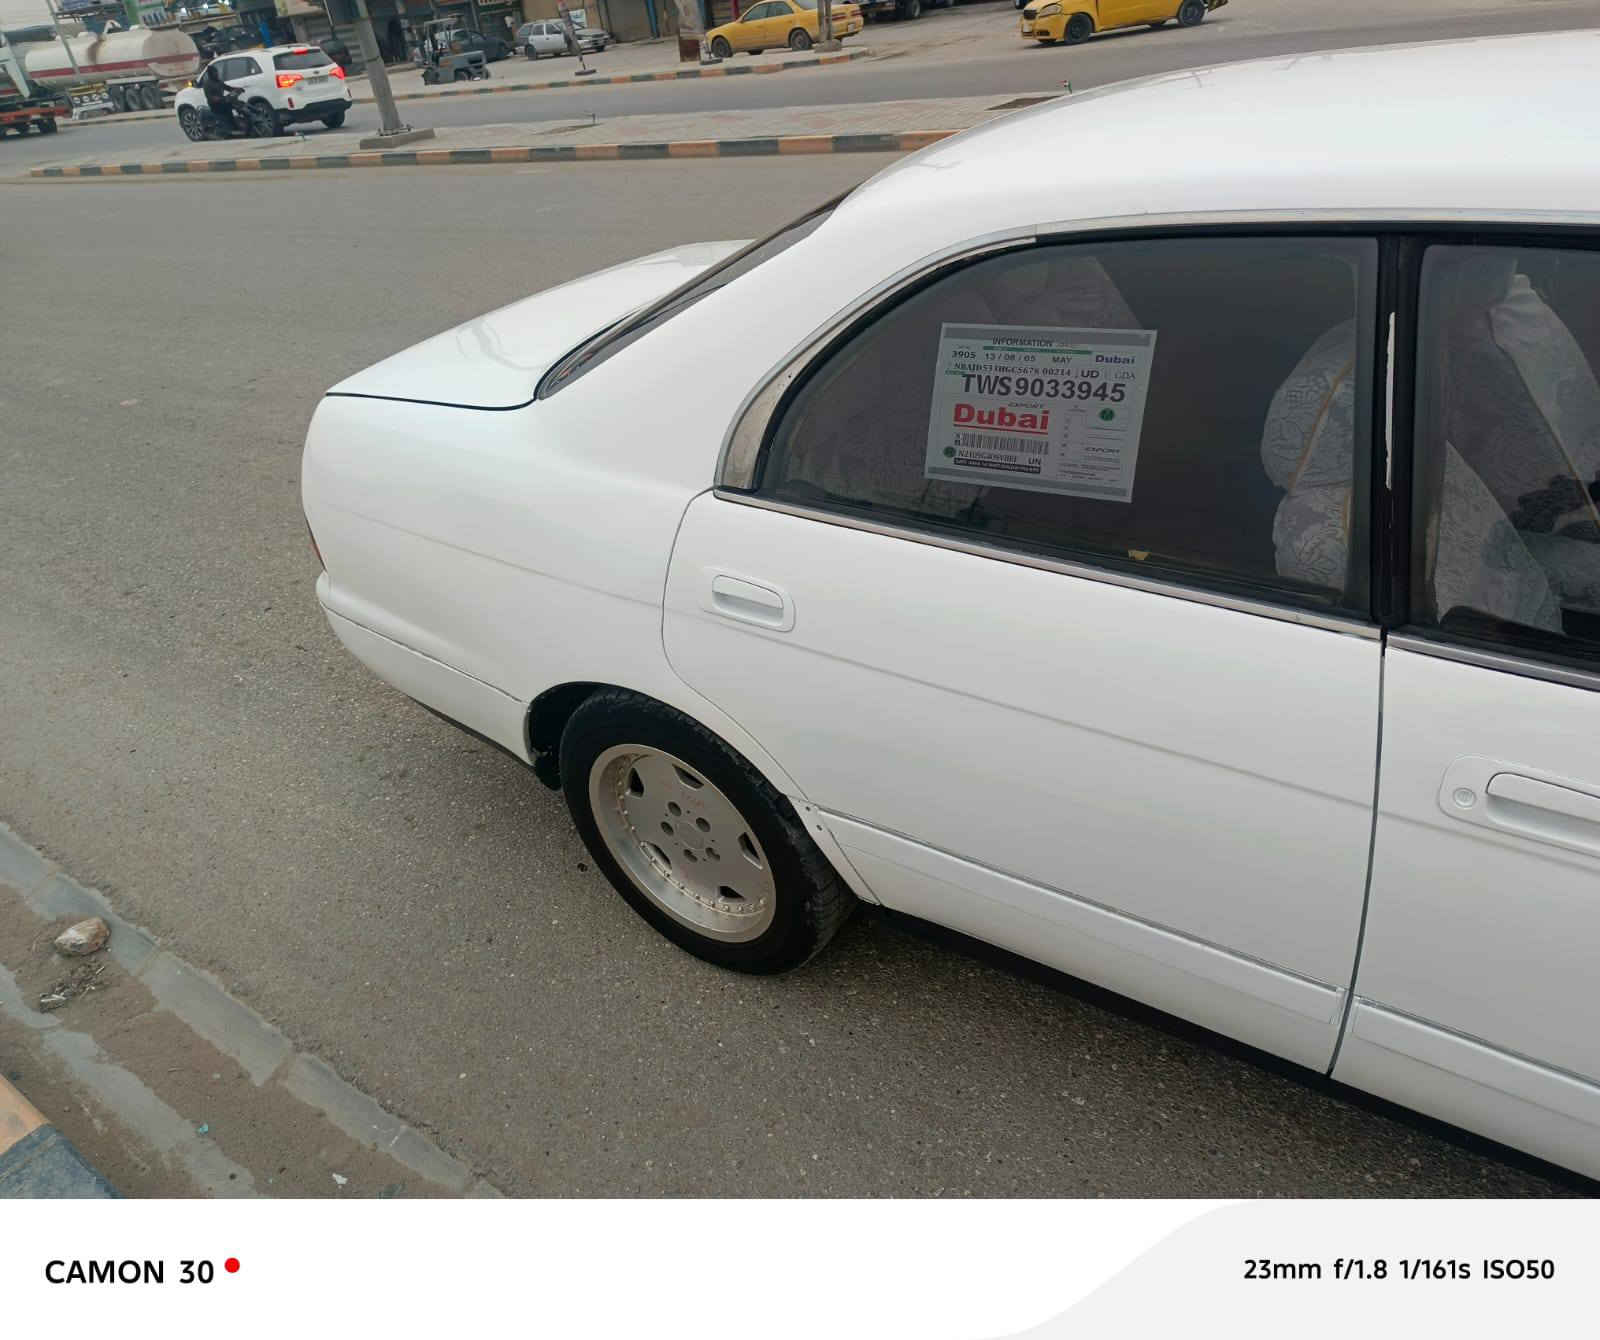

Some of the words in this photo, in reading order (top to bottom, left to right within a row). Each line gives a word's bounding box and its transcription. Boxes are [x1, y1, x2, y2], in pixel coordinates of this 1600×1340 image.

[992, 336, 1053, 348] INFORMATION
[951, 350, 976, 359] 3905
[1052, 355, 1073, 364] MAY
[1095, 354, 1135, 364] Dubai
[1080, 369, 1100, 379] UD
[961, 373, 1126, 403] TWS9033945
[953, 403, 1050, 431] Dubai
